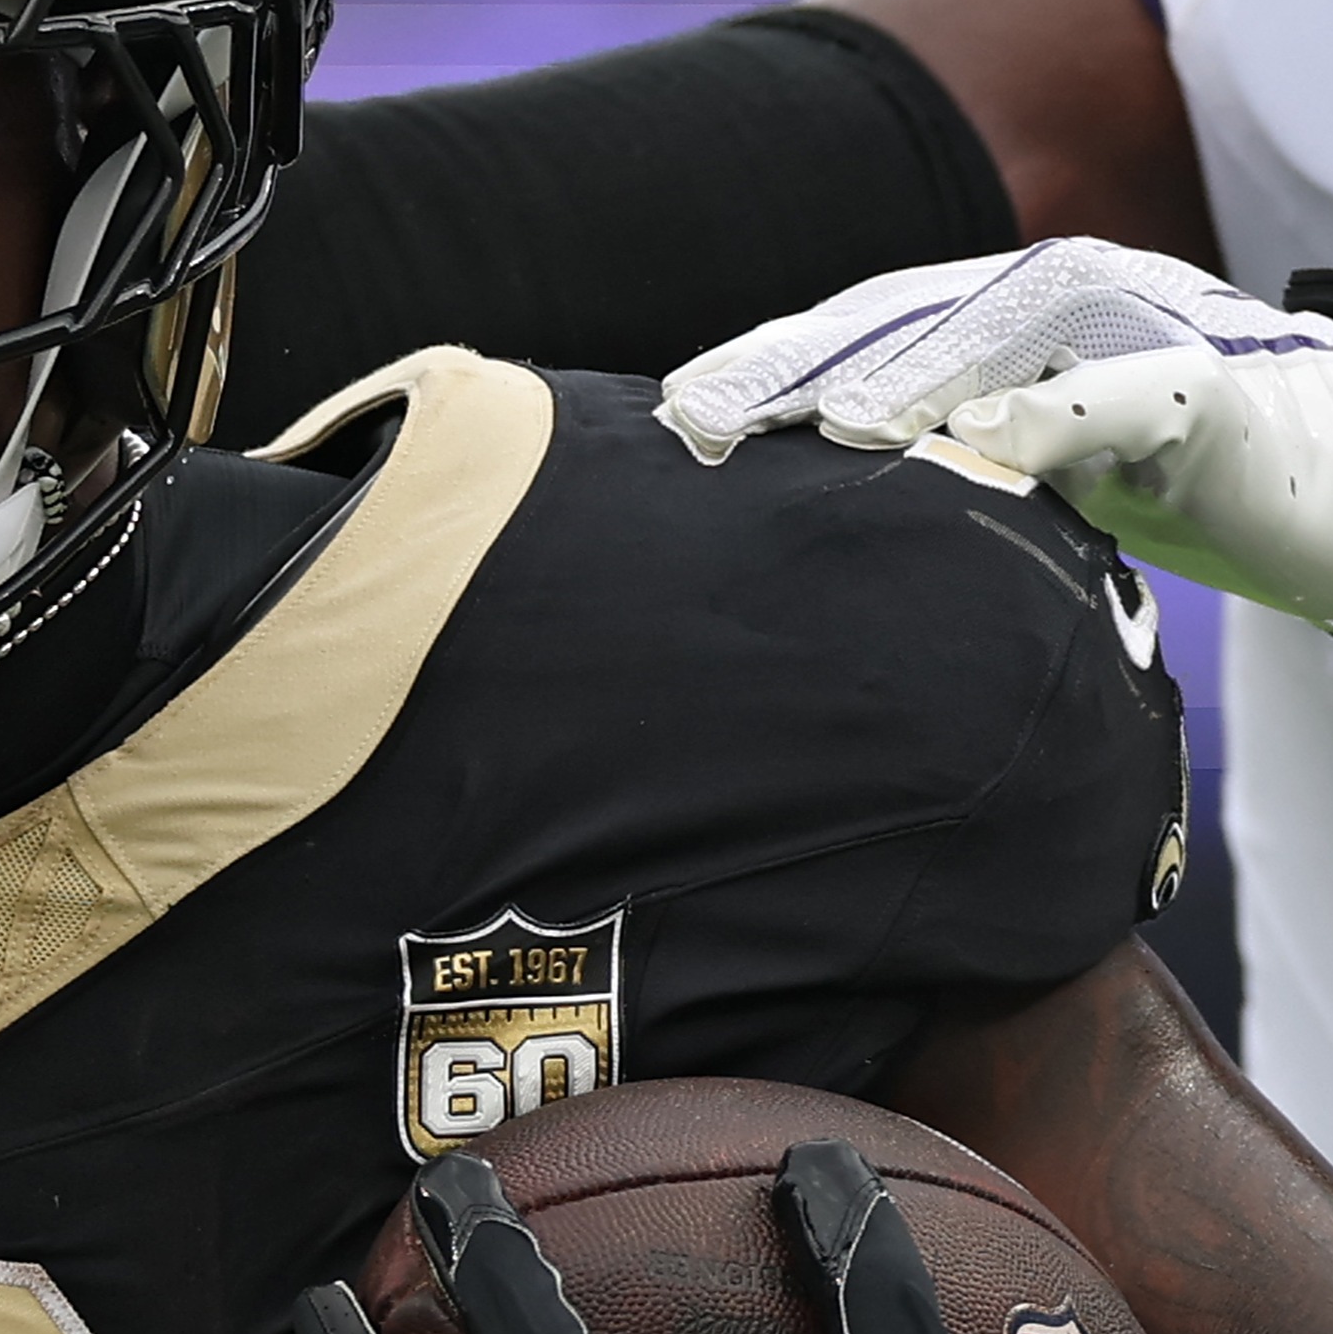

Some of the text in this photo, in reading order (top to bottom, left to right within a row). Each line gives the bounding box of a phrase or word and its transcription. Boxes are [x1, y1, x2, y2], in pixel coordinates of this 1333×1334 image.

[433, 947, 588, 992] EST. 1967
[419, 1031, 598, 1137] 60
